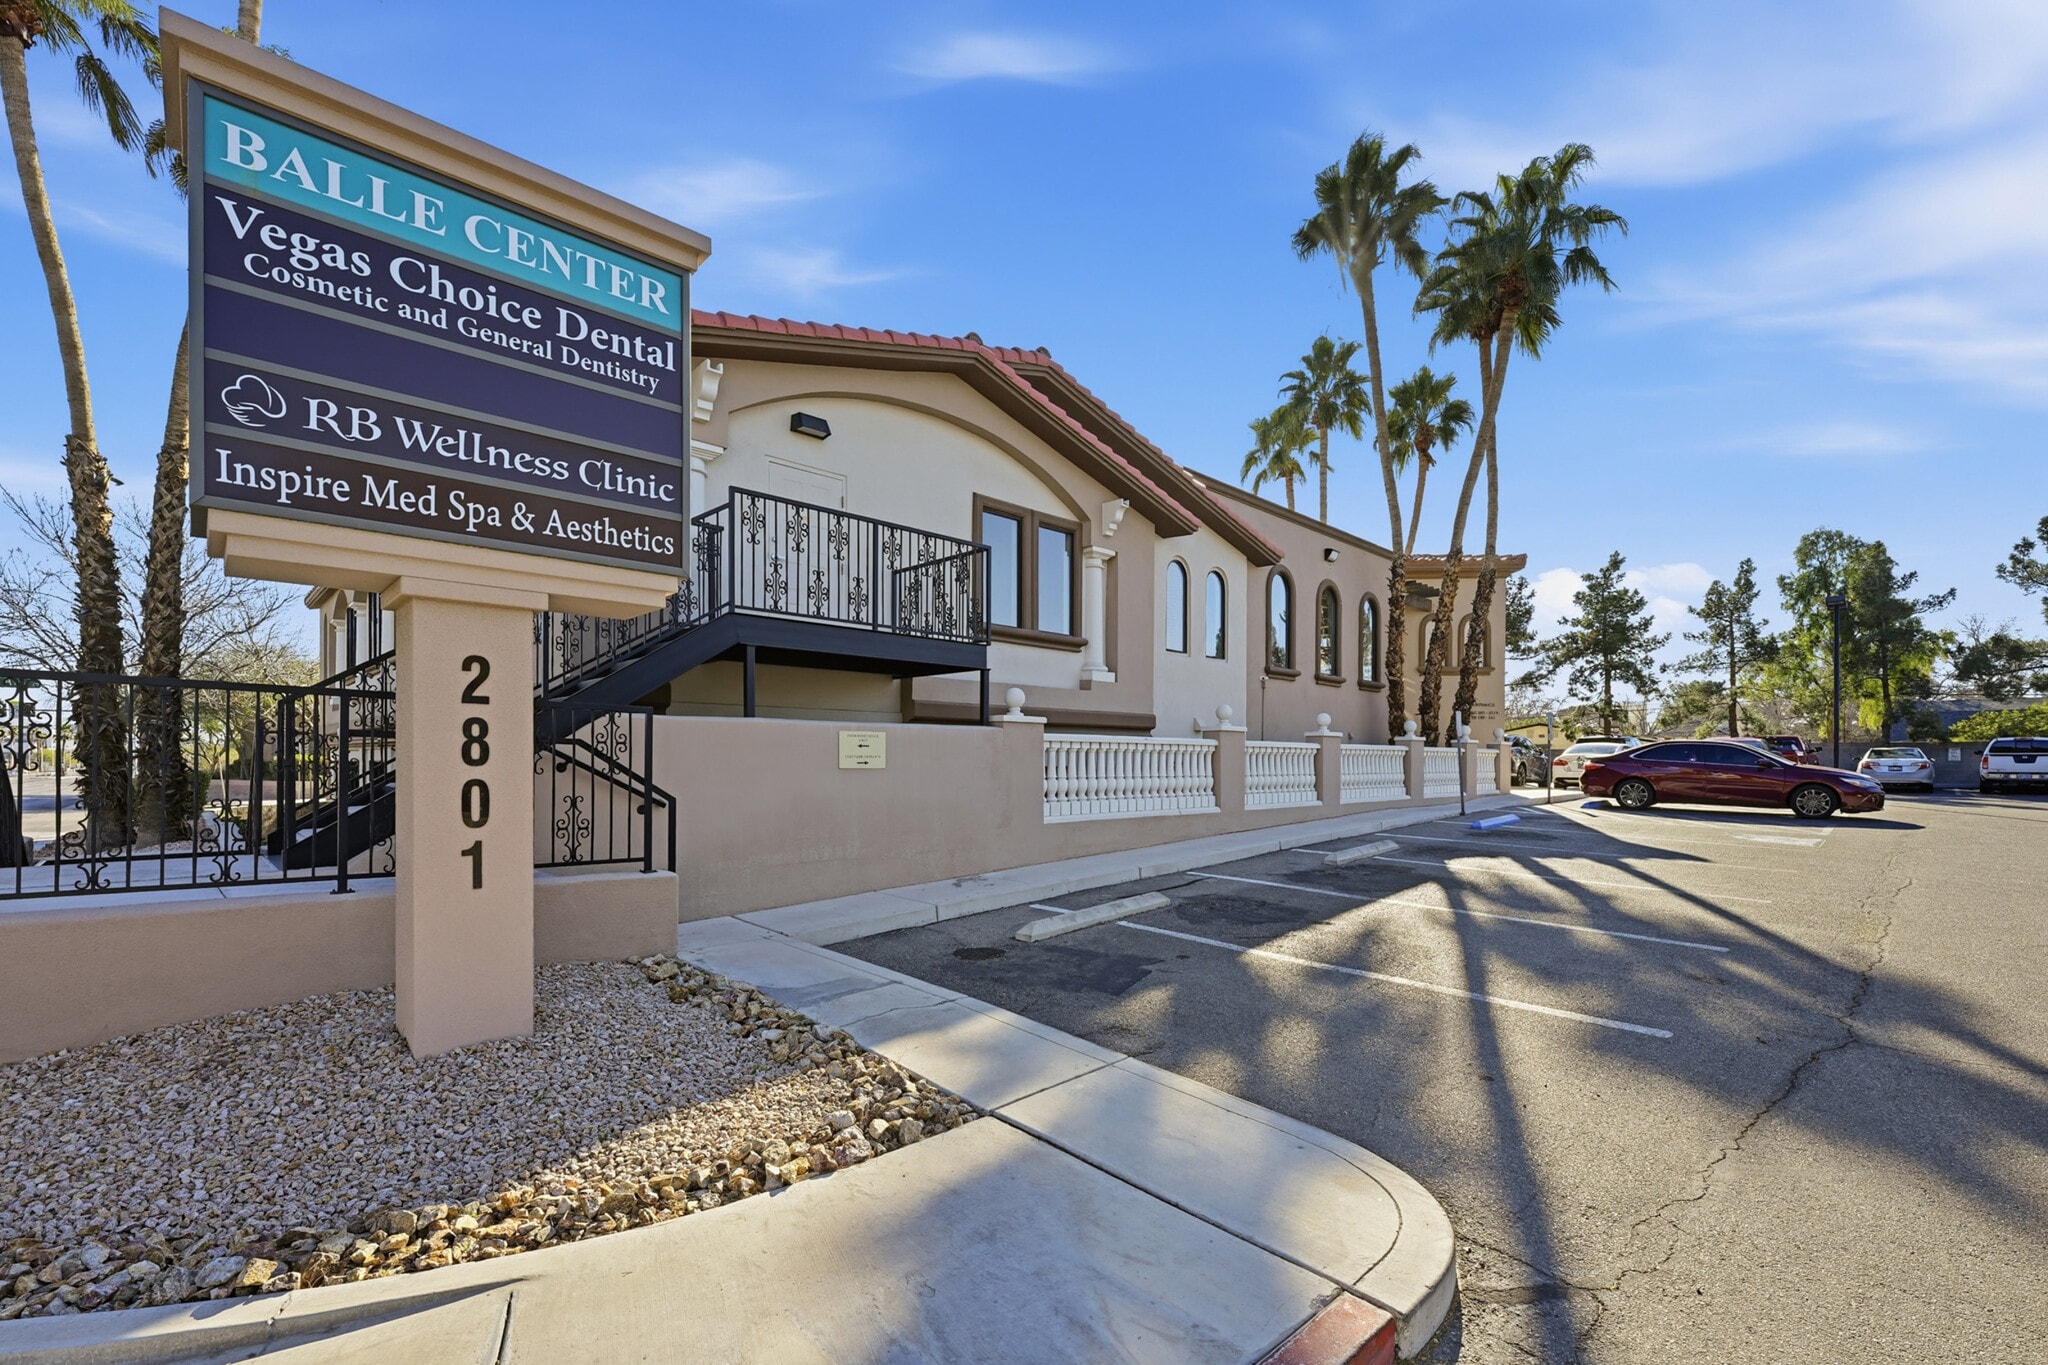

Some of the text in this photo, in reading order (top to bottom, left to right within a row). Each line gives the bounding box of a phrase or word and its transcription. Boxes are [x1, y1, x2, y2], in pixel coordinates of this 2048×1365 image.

[215, 196, 676, 371] Vegas Choice Dental
[220, 120, 669, 314] BALLE CENTER
[244, 254, 660, 394] Cosmetic and General Dentistry
[215, 449, 674, 554] Inspire Med Spa & Aesthetics
[302, 397, 675, 502] RB Wellness Clinic
[461, 655, 490, 889] 2801
